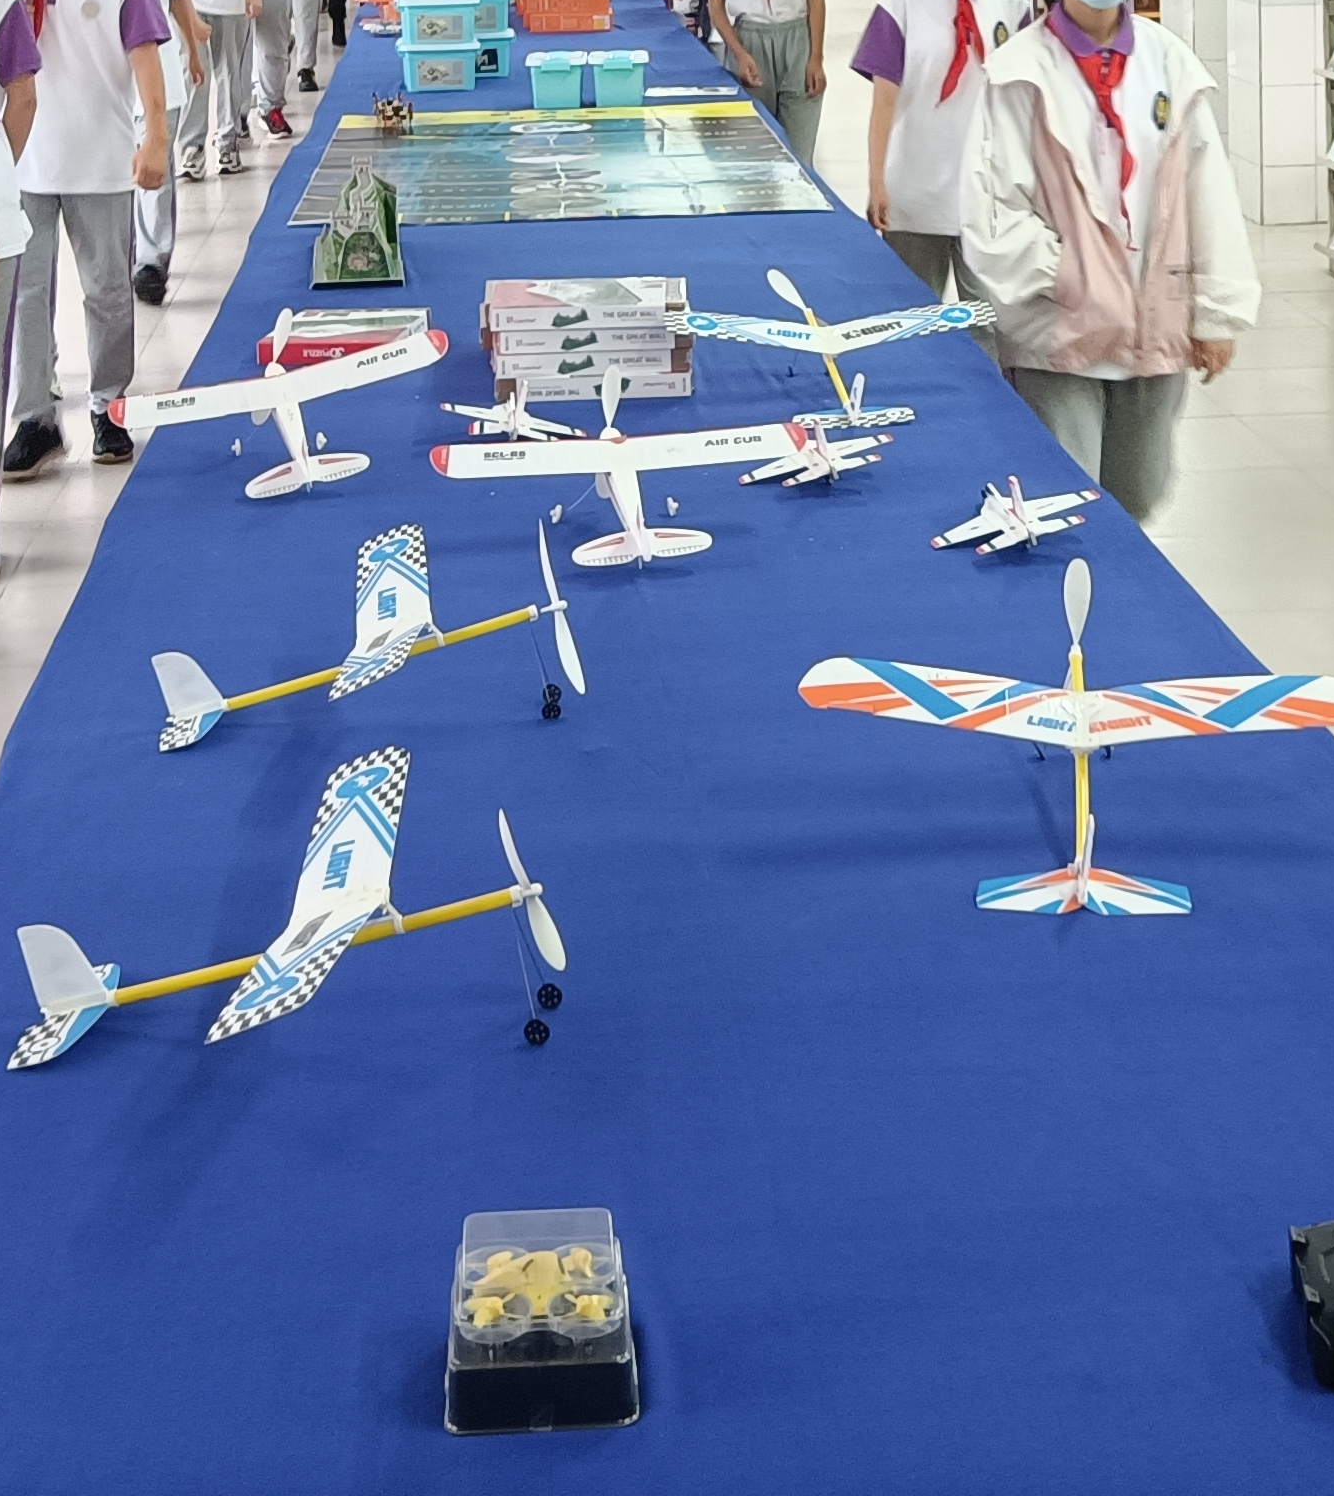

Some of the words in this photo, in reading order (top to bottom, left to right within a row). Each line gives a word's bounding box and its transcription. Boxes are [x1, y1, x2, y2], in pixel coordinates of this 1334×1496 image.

[767, 327, 814, 341] LIGHT
[704, 439, 729, 447] AIR
[322, 839, 356, 891] LIGHT
